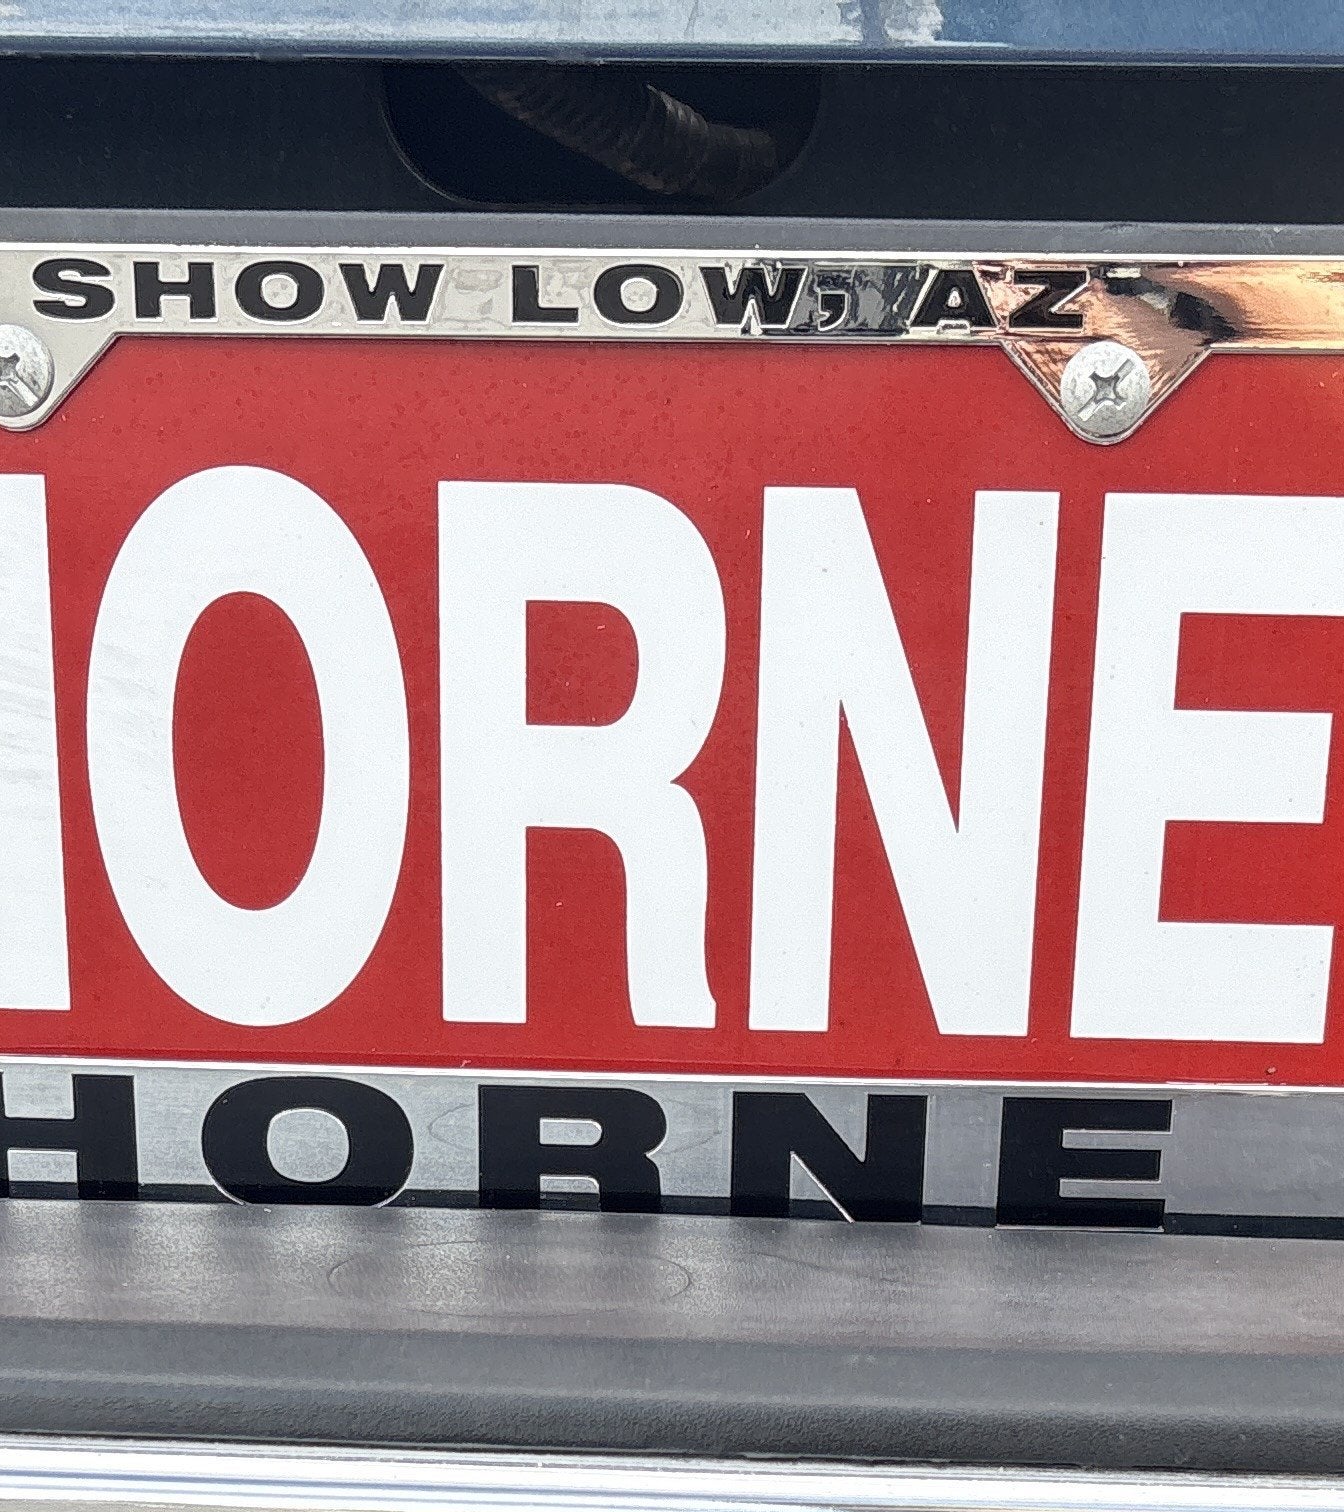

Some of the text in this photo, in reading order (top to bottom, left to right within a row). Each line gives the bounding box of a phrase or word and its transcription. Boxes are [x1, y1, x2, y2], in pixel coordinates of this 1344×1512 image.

[31, 257, 1089, 332] SHOW LOW, AZ
